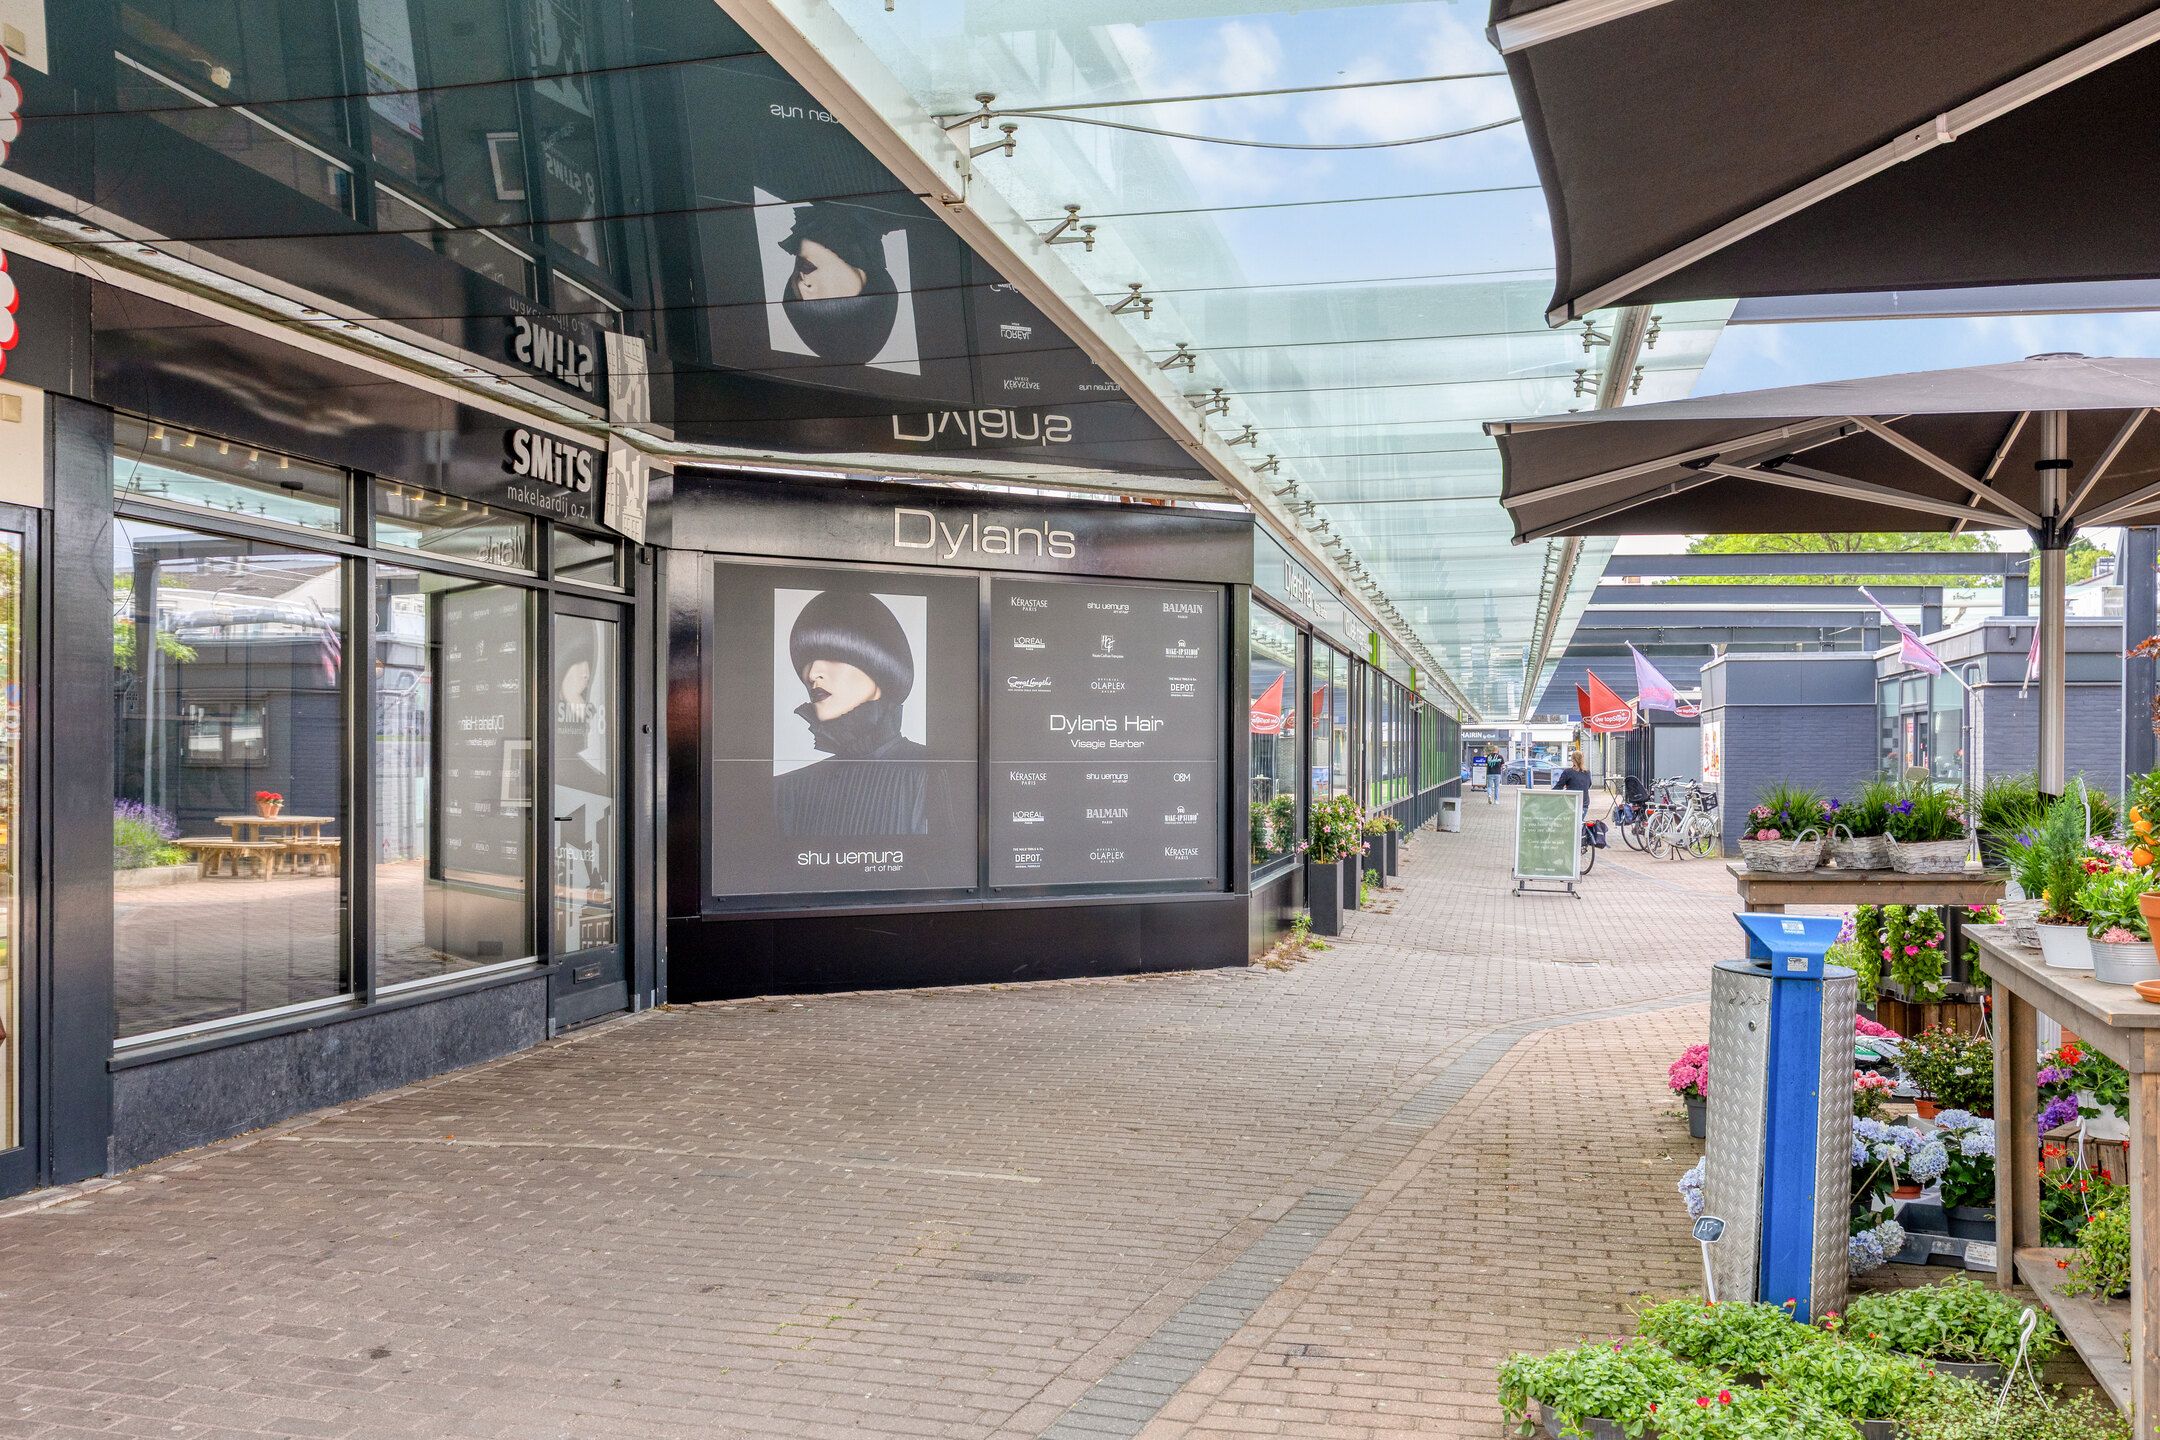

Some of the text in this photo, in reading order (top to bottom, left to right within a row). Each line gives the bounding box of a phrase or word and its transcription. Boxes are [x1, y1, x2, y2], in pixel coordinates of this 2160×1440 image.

[507, 484, 589, 520] makelaardij o.z.
[894, 507, 1076, 560] Dylan's
[1010, 596, 1048, 608] KÉRASTASE
[1101, 603, 1130, 611] uemura
[1162, 602, 1203, 614] BALMAIN
[1013, 636, 1045, 645] L'ORÉAL
[1090, 681, 1125, 690] OLAPLEX
[1049, 714, 1164, 735] Dylan's Hair
[1070, 739, 1145, 750] Visagie Barber
[1009, 771, 1047, 781] KÉRASTASE
[1086, 772, 1100, 780] shu
[1012, 810, 1044, 818] L'ORÉAL
[1086, 808, 1128, 818] BALMAIN
[1089, 851, 1124, 860] OLAPLEX
[1164, 846, 1199, 856] KÉRASTASE
[797, 850, 903, 866] shu uemura
[877, 864, 886, 872] of
[887, 864, 903, 872] hair
